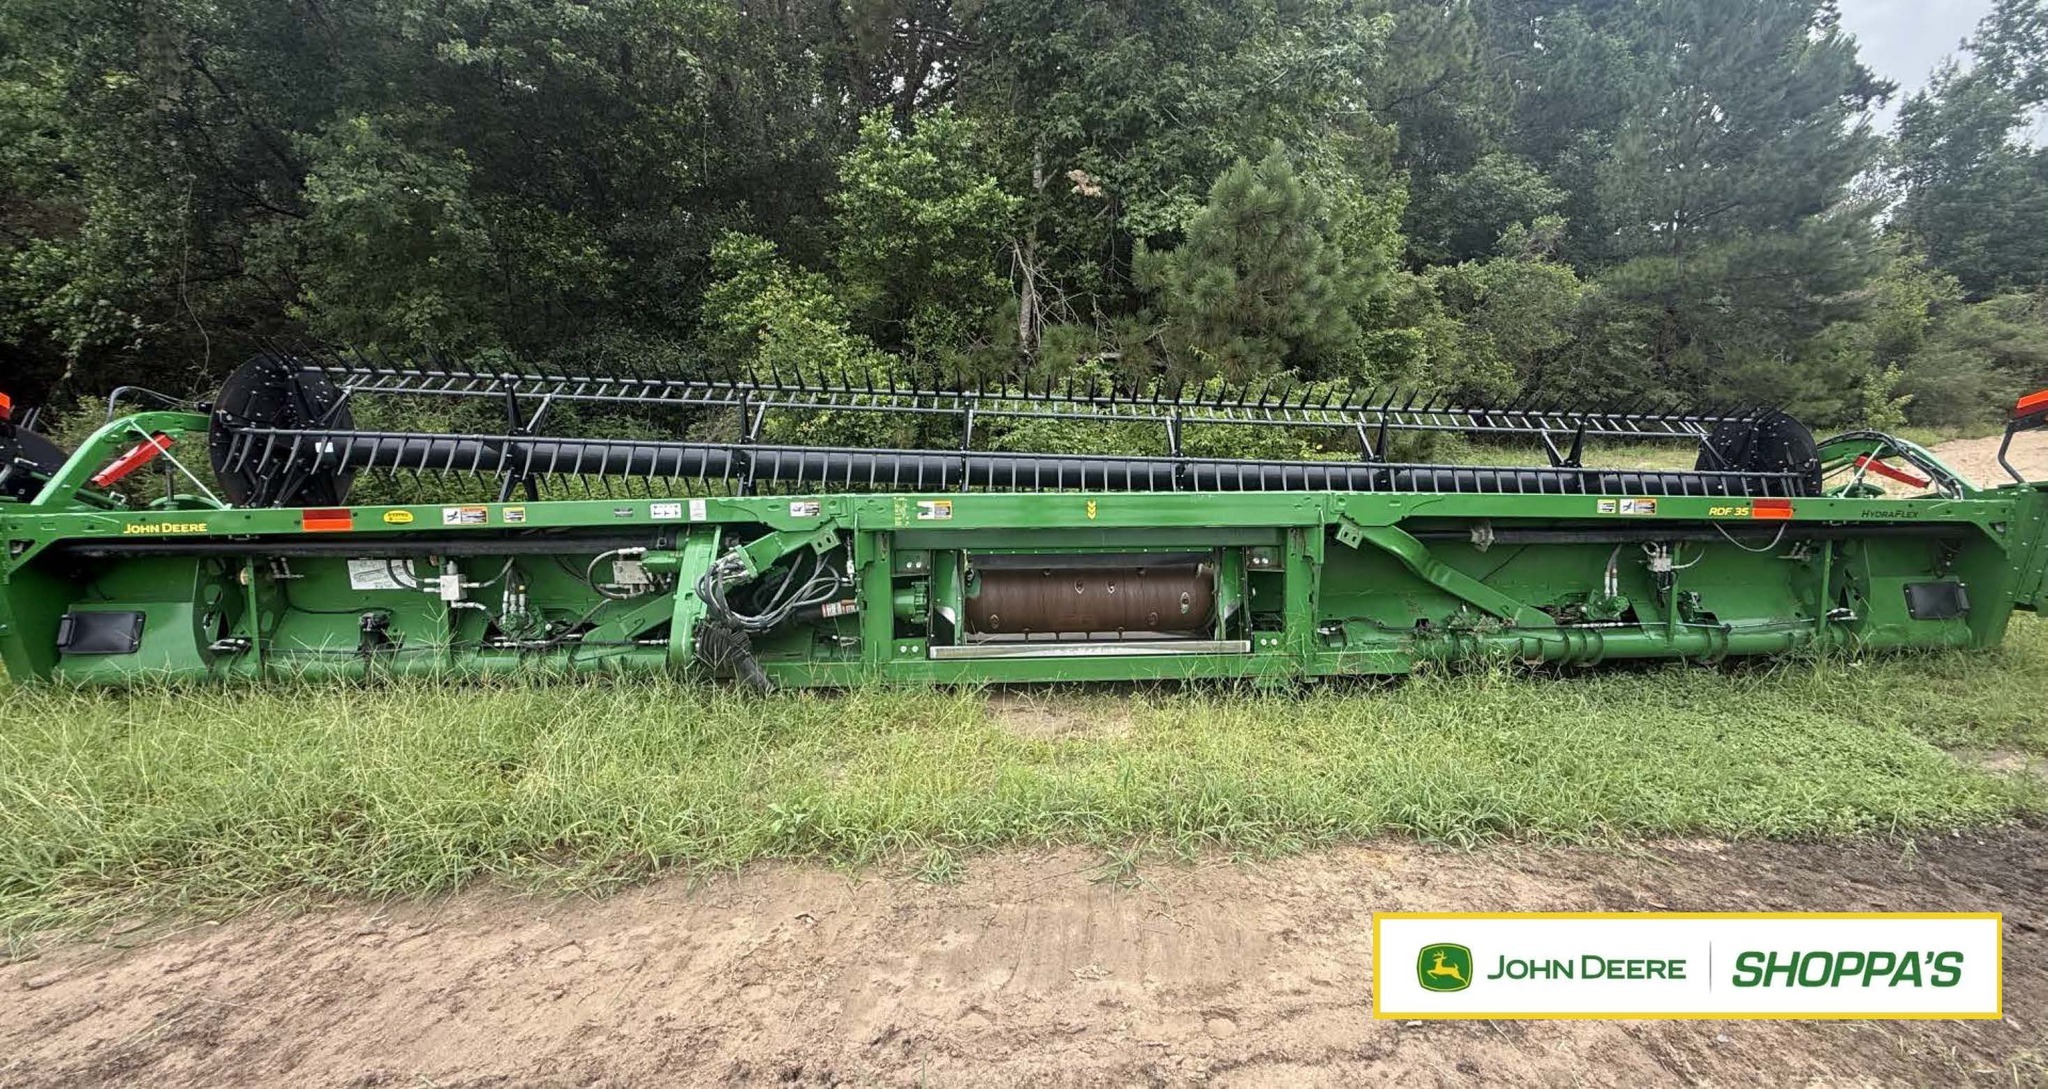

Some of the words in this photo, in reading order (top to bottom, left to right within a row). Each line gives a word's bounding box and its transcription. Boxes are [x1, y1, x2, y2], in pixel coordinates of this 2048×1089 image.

[1708, 507, 1732, 516] RDF
[1733, 507, 1749, 516] 35
[123, 524, 159, 534] JOHN
[162, 523, 207, 533] DEERE
